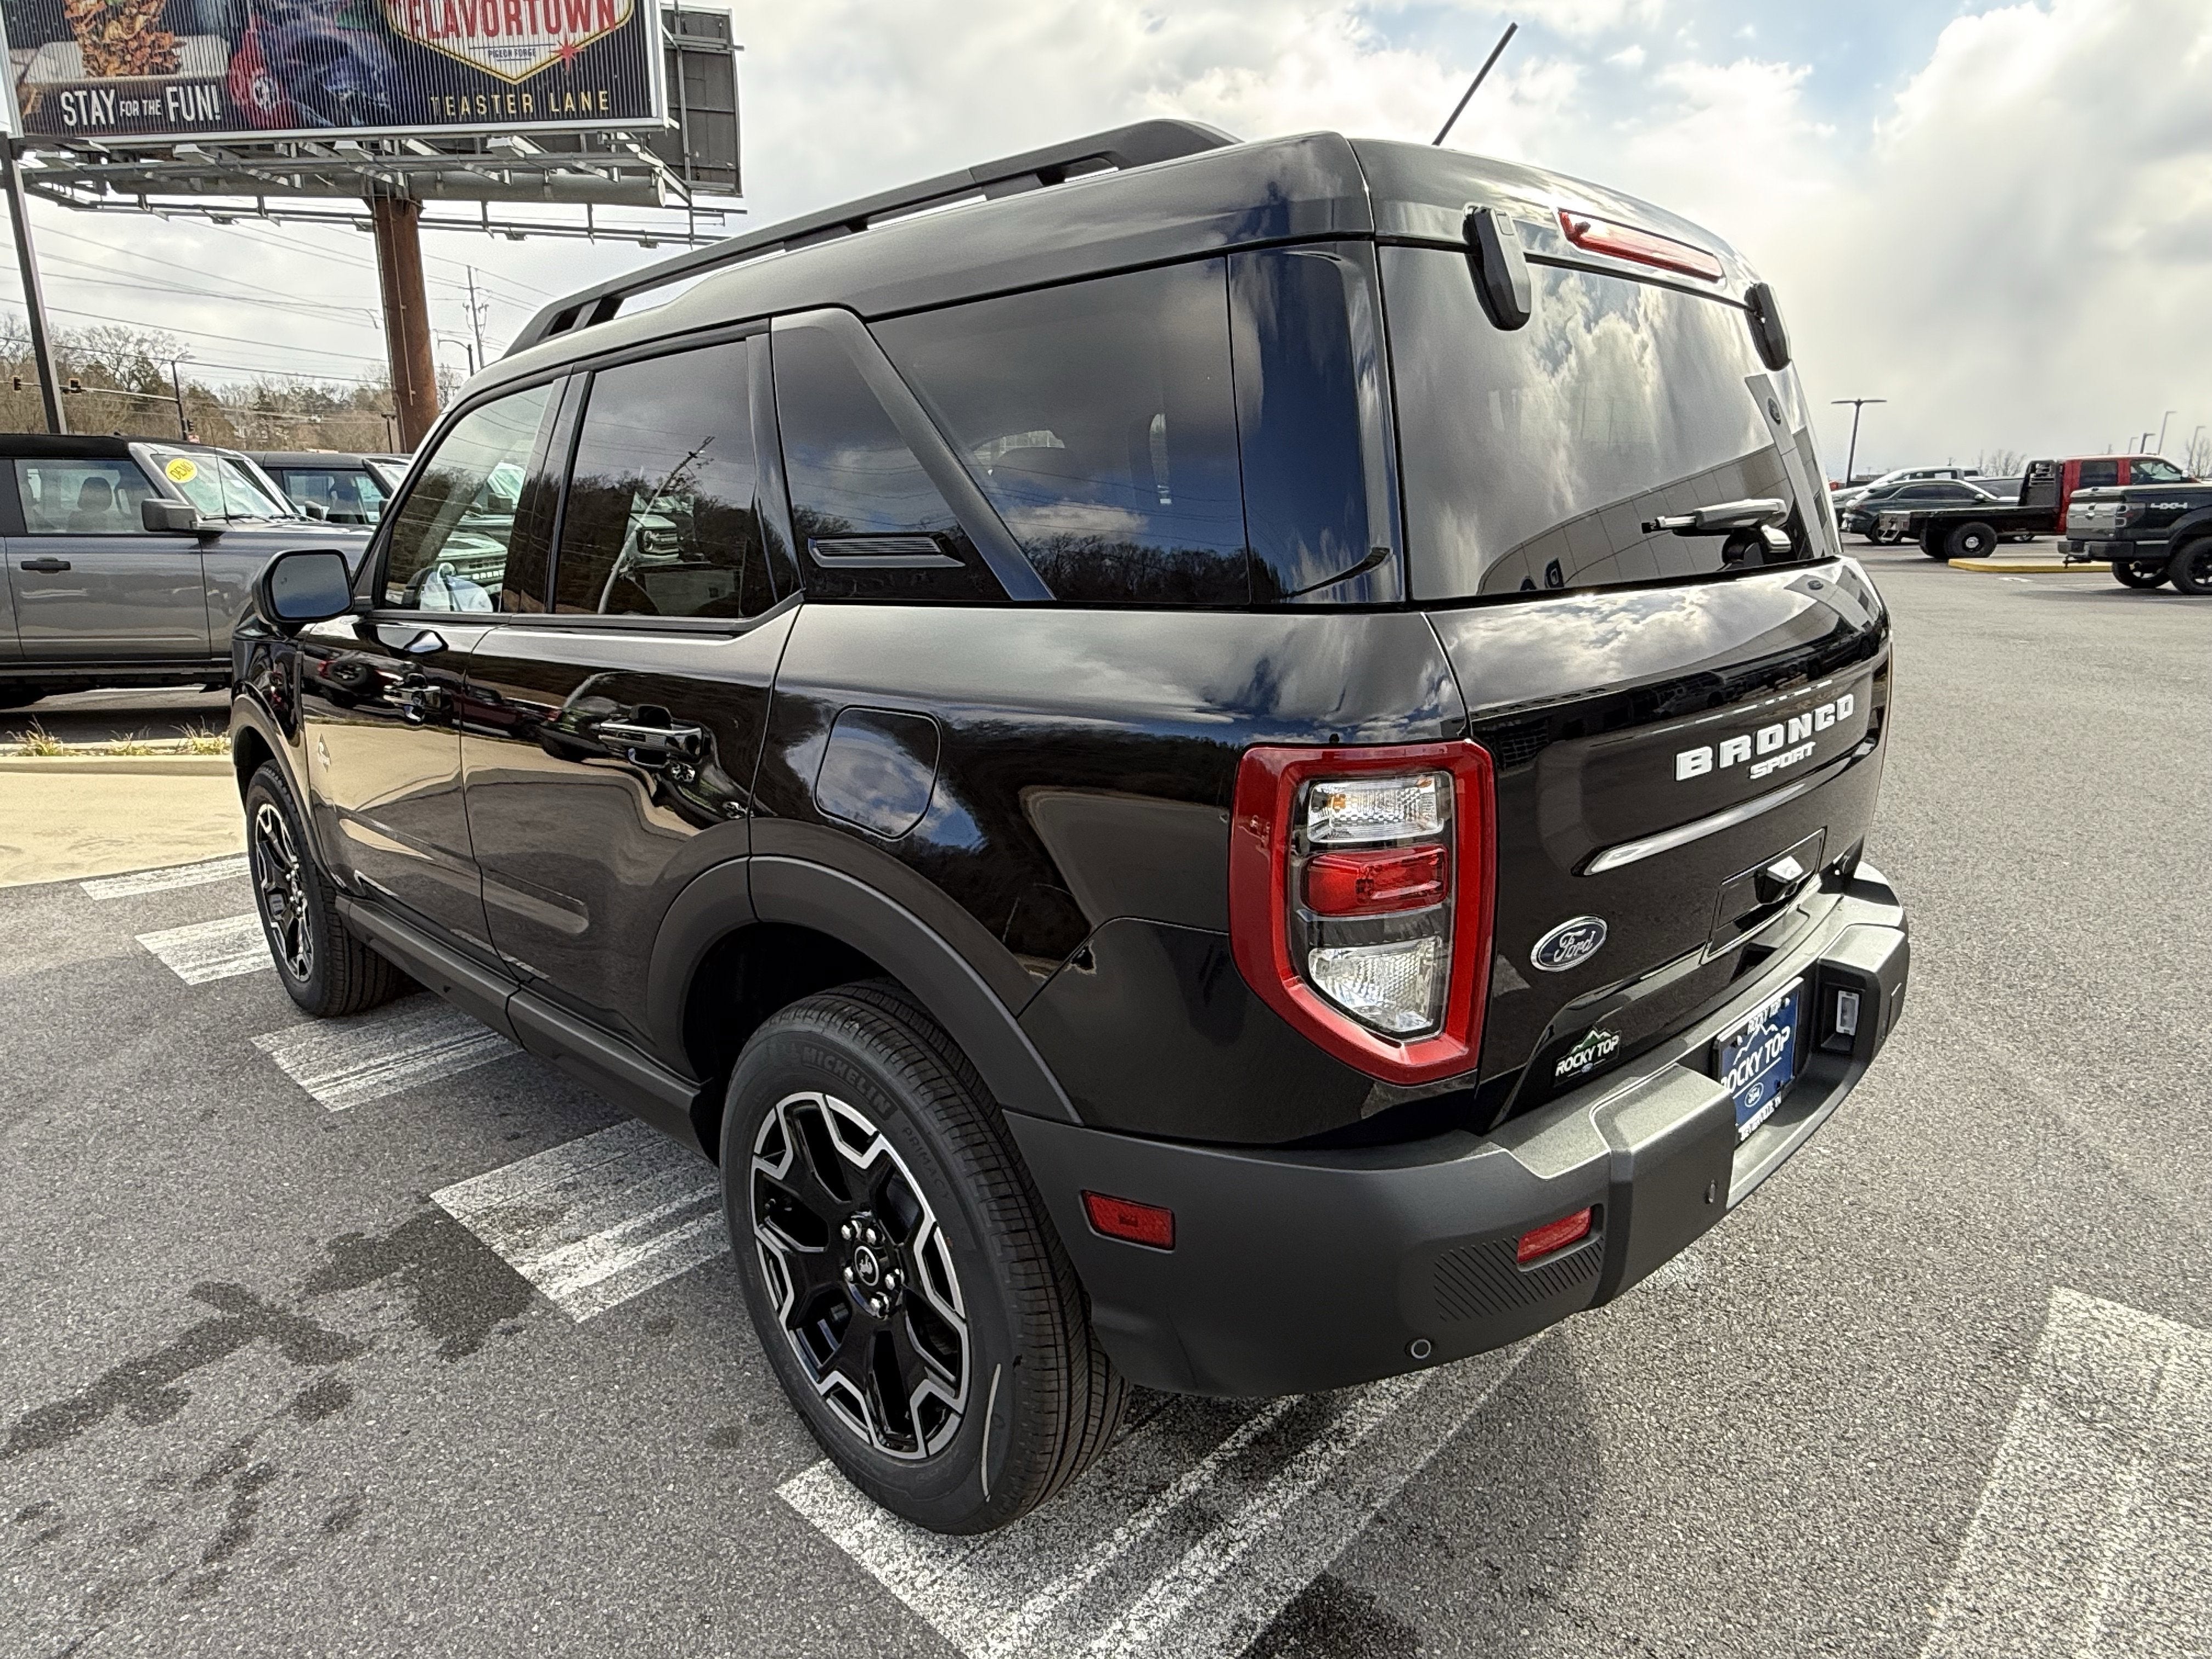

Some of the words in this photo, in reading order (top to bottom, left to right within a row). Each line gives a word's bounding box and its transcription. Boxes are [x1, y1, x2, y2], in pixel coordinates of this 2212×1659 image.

[408, 0, 616, 40] FLAVORTOWN
[60, 89, 115, 126] STAY
[120, 100, 139, 117] FOR
[142, 99, 162, 116] THE
[166, 84, 221, 122] FUN!
[430, 93, 533, 116] TEASTER
[550, 91, 609, 112] LANE
[1675, 693, 1854, 781] BRONCO
[1749, 741, 1816, 780] SPORT
[1553, 928, 1597, 963] Ford
[1555, 1045, 1596, 1076] ROCKY
[1596, 1035, 1620, 1057] TOP
[1764, 1025, 1791, 1064] TOP
[802, 1046, 891, 1114] MICHELIN
[901, 1126, 952, 1201] PRIMACY
